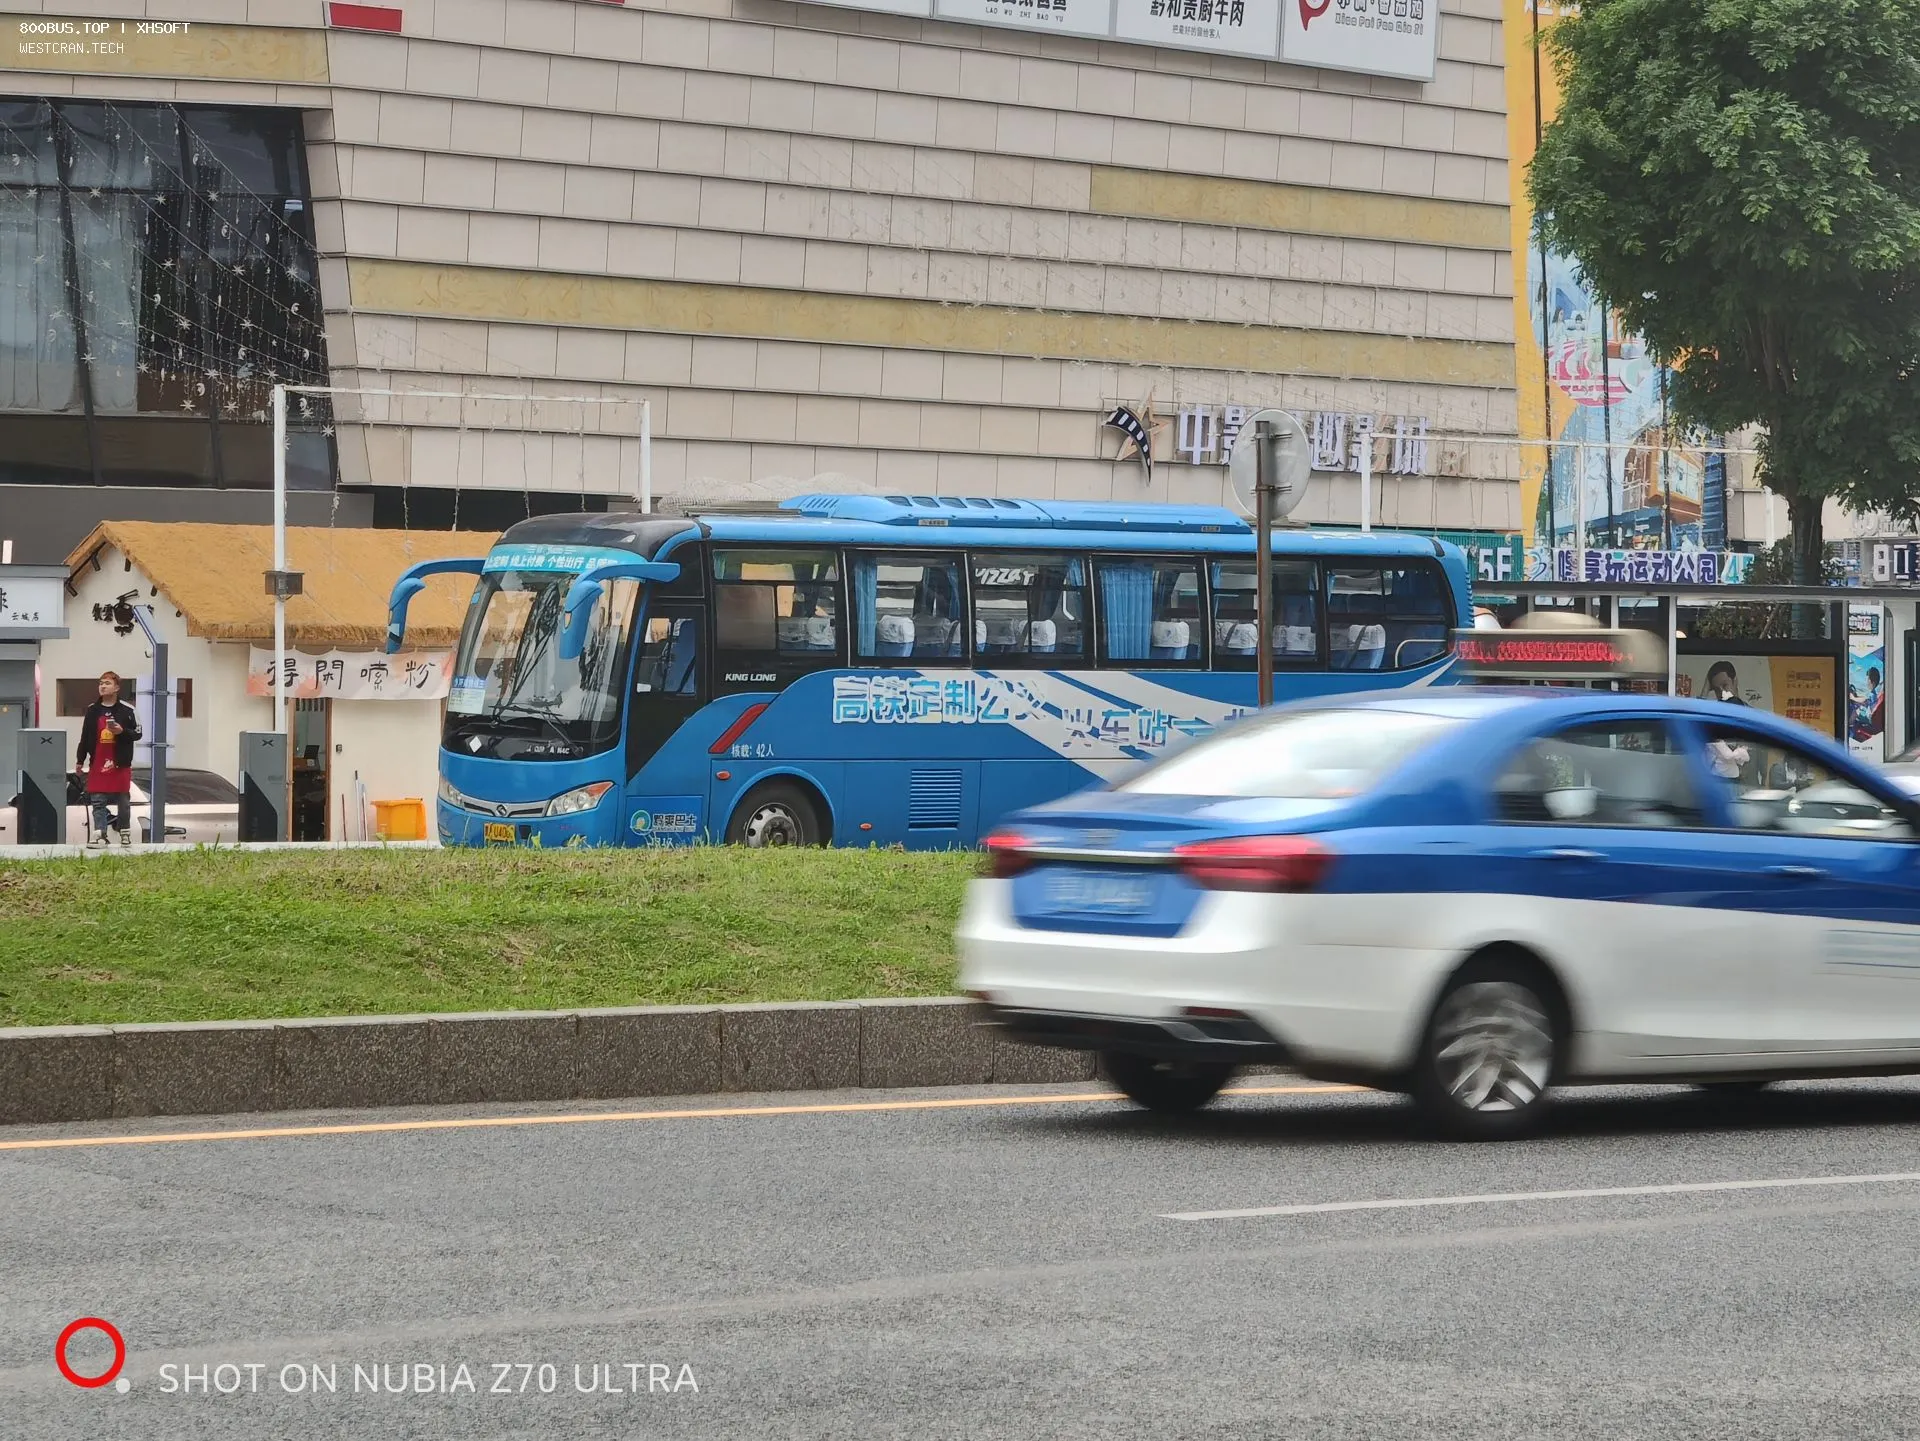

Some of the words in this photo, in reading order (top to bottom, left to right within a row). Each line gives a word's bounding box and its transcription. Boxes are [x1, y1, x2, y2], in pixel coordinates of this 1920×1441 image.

[985, 7, 998, 15] LAO
[725, 673, 749, 681] KING
[749, 673, 777, 681] LONG
